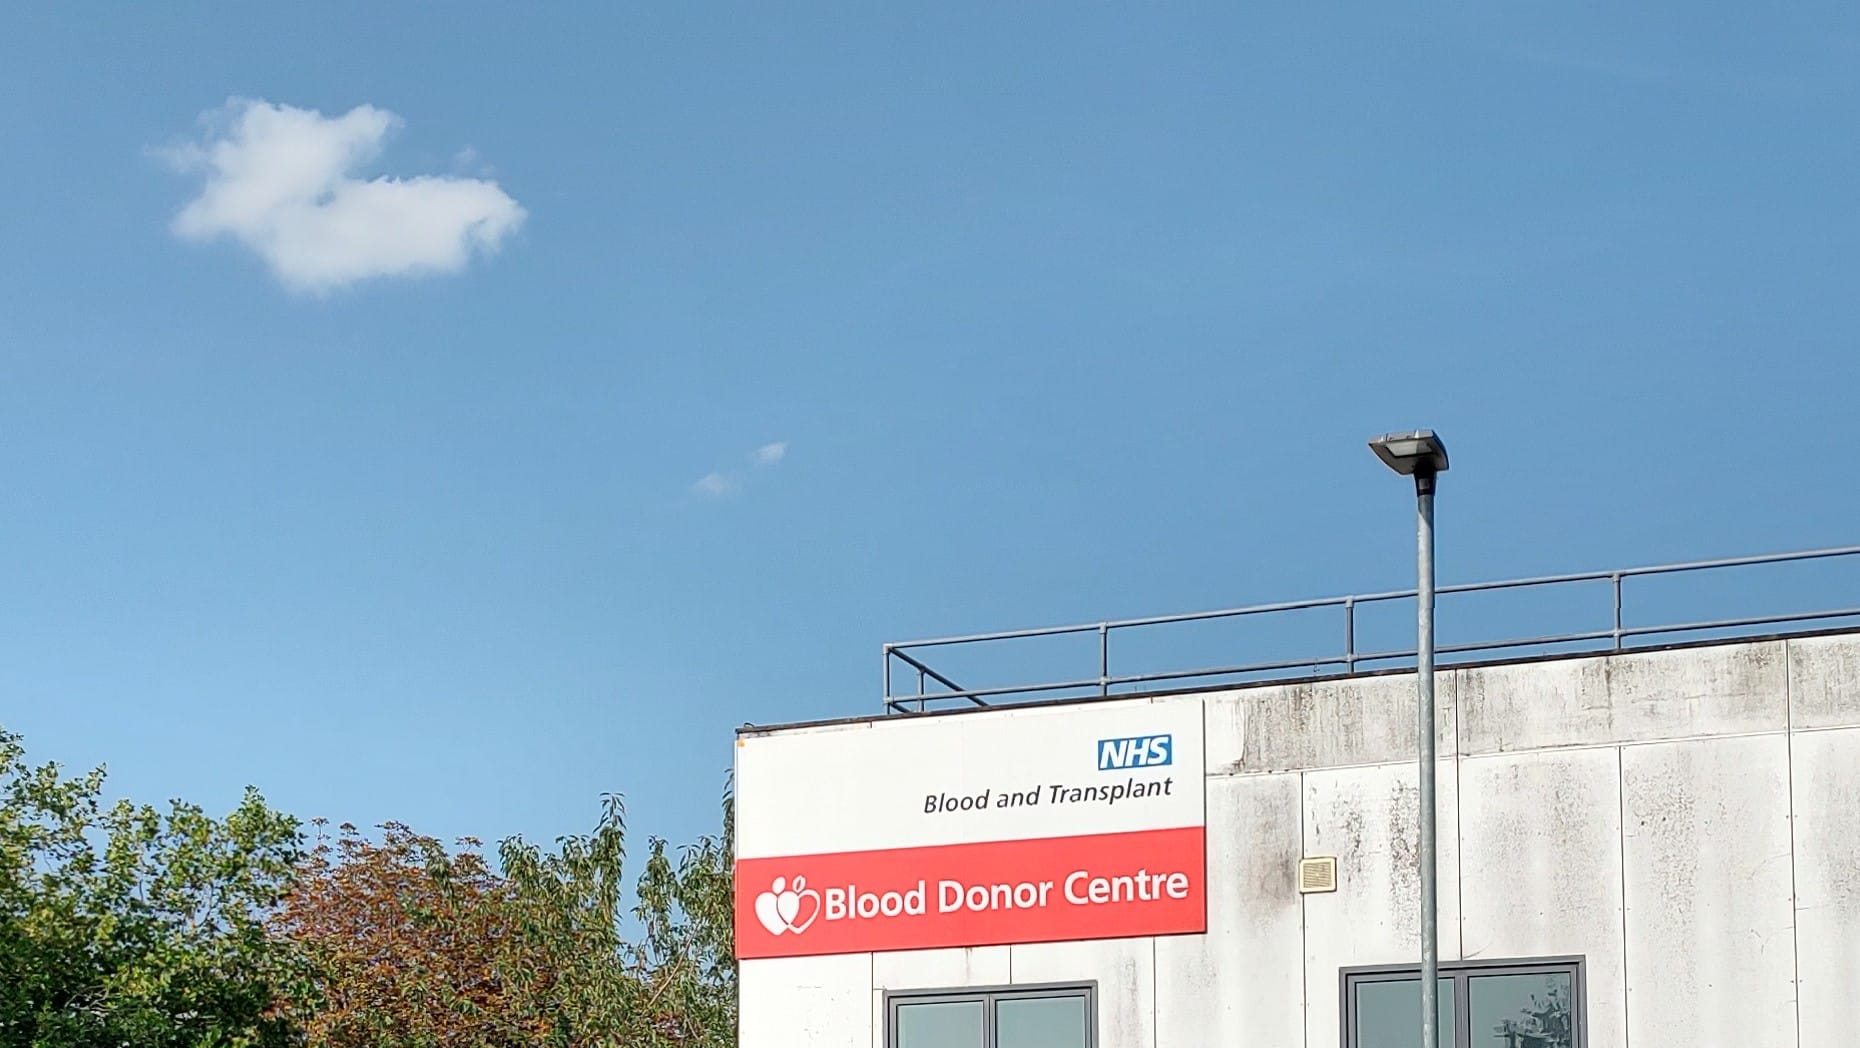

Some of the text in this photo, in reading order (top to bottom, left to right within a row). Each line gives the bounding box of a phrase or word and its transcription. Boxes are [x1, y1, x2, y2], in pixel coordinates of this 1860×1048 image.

[1100, 737, 1169, 769] NHS
[924, 777, 1173, 814] Blood and Transplant
[824, 869, 1189, 921] Blood Donor Centre
